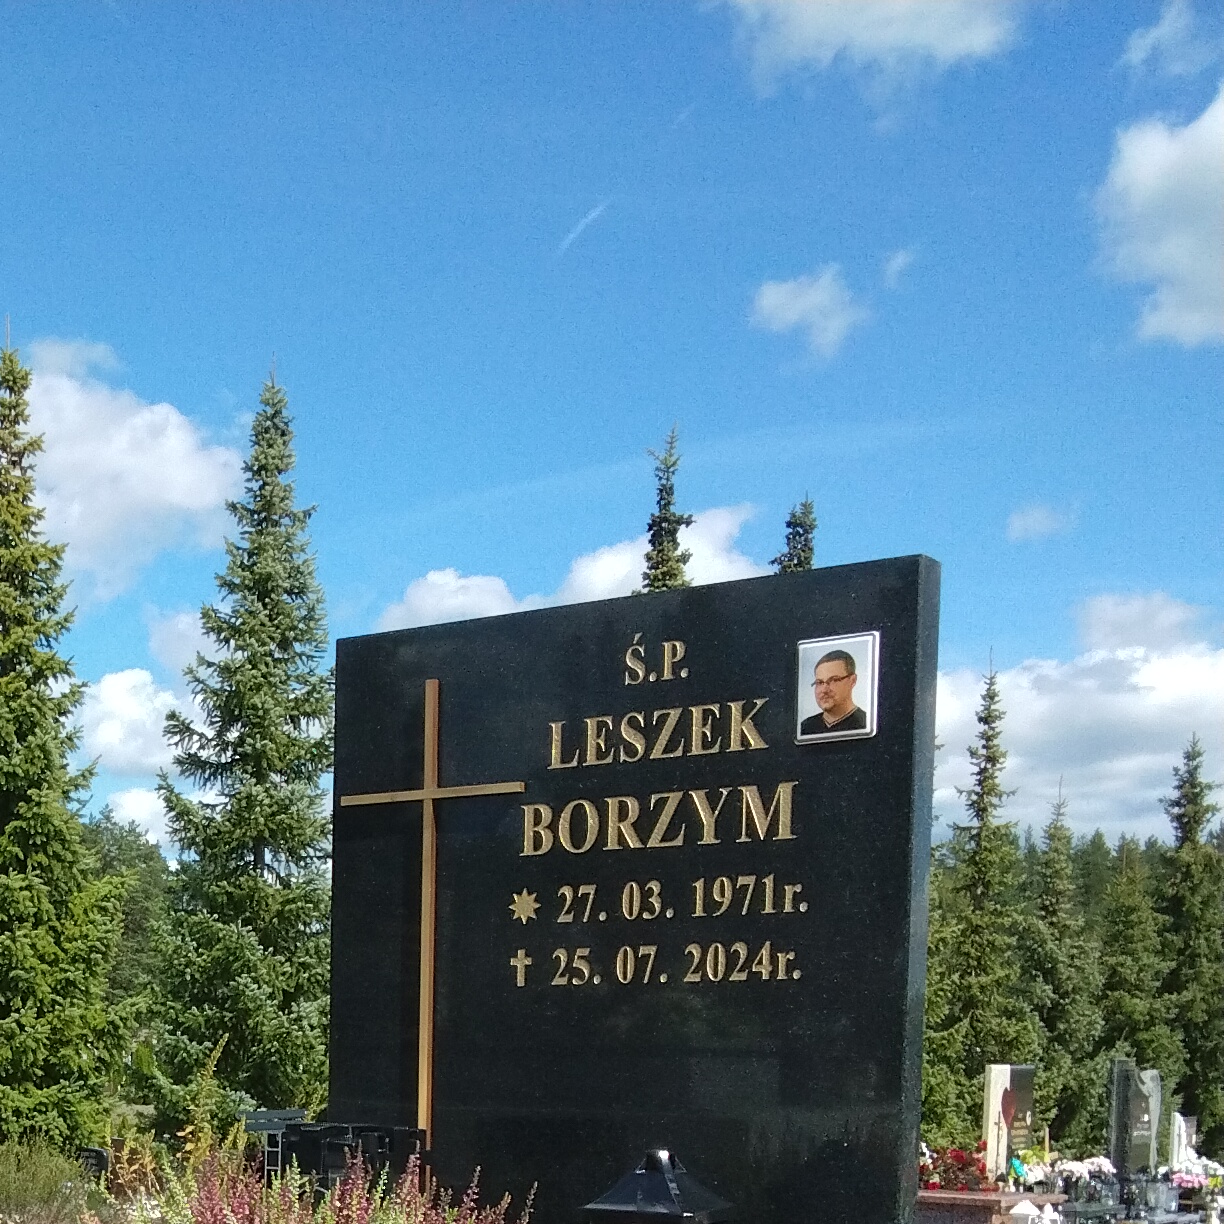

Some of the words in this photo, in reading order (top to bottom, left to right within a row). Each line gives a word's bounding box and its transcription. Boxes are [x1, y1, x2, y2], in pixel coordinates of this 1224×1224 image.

[624, 632, 689, 686] Ś.P.
[547, 697, 770, 770] LESZEK
[519, 780, 799, 857] BORZYM
[556, 884, 607, 923] 27.
[622, 880, 675, 920] 03.
[690, 874, 809, 917] 1971r.
[550, 947, 603, 986] 25.
[616, 945, 669, 984] 07.
[683, 940, 802, 983] 2024r.
